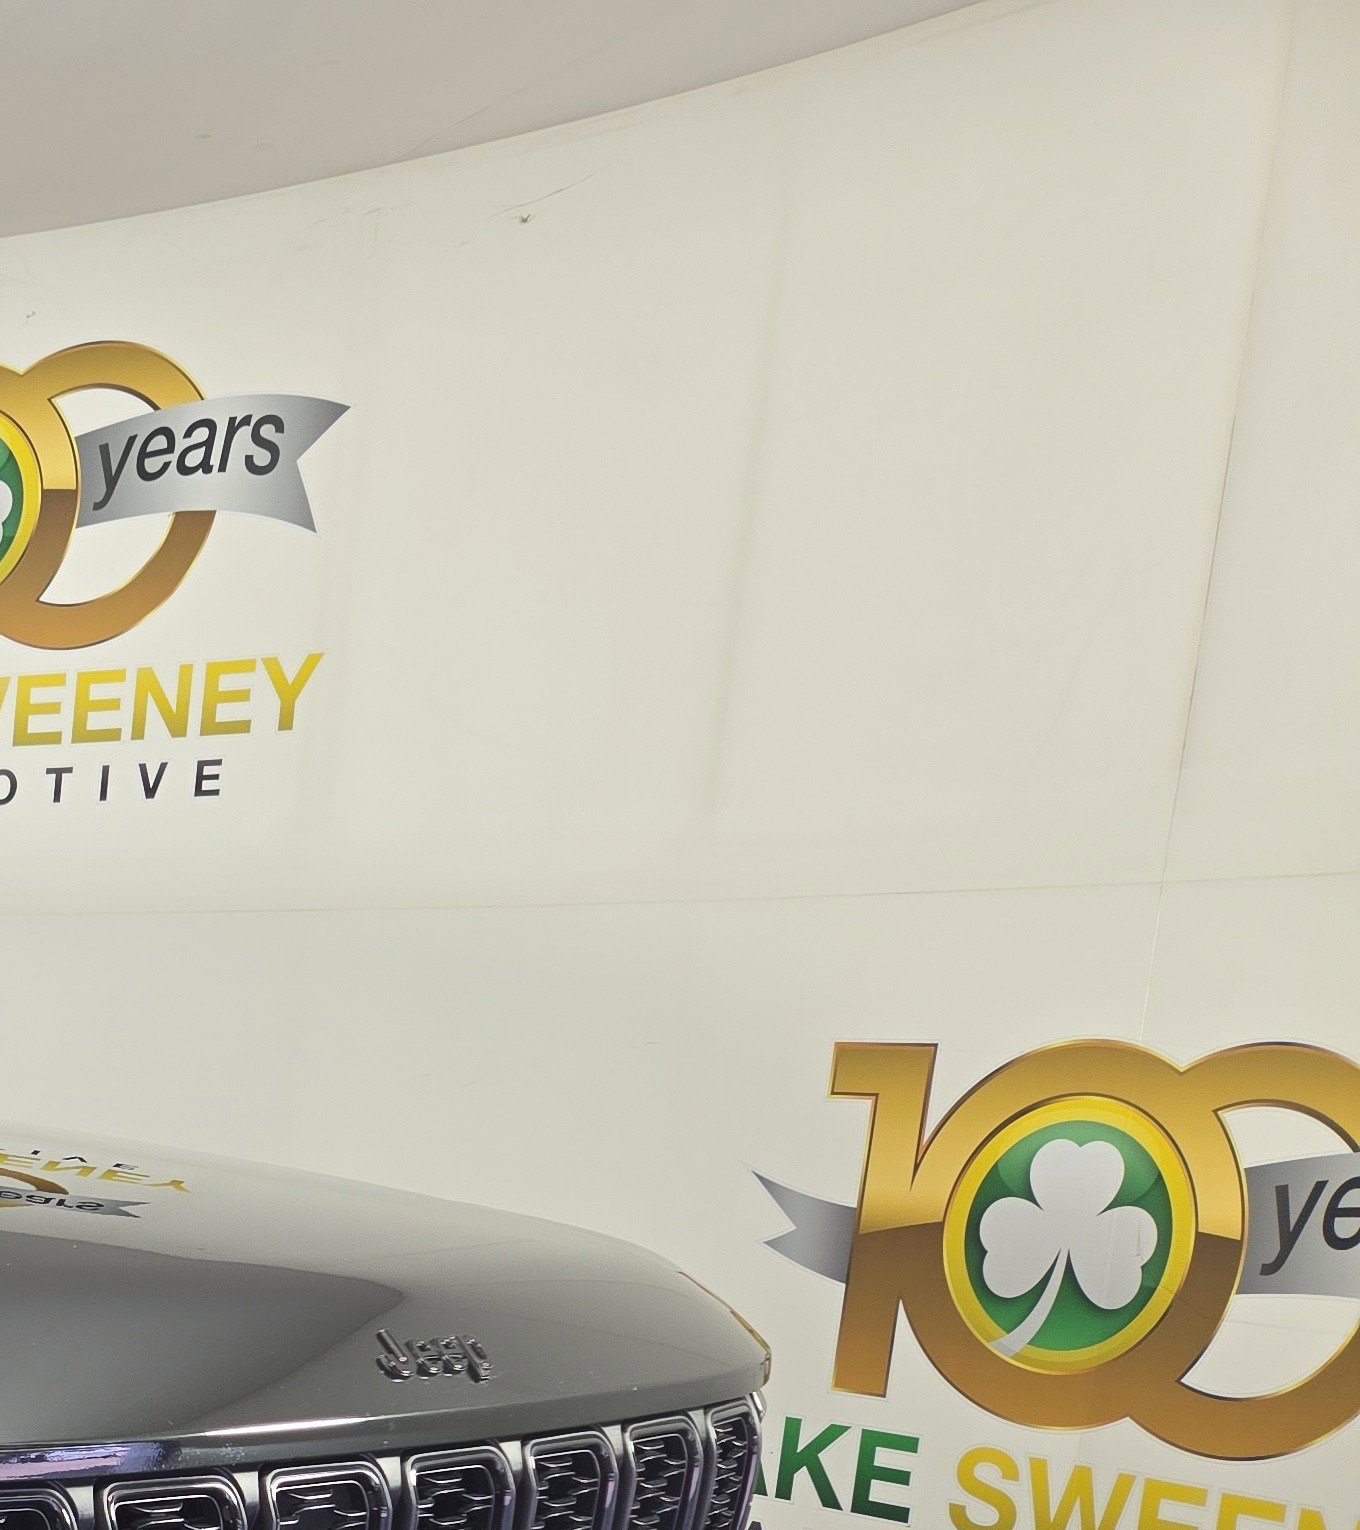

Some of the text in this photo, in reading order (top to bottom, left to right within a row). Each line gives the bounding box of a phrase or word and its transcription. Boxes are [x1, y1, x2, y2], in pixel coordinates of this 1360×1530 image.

[92, 410, 285, 511] years
[376, 1328, 494, 1384] Jeep
[753, 1416, 920, 1524] KE
